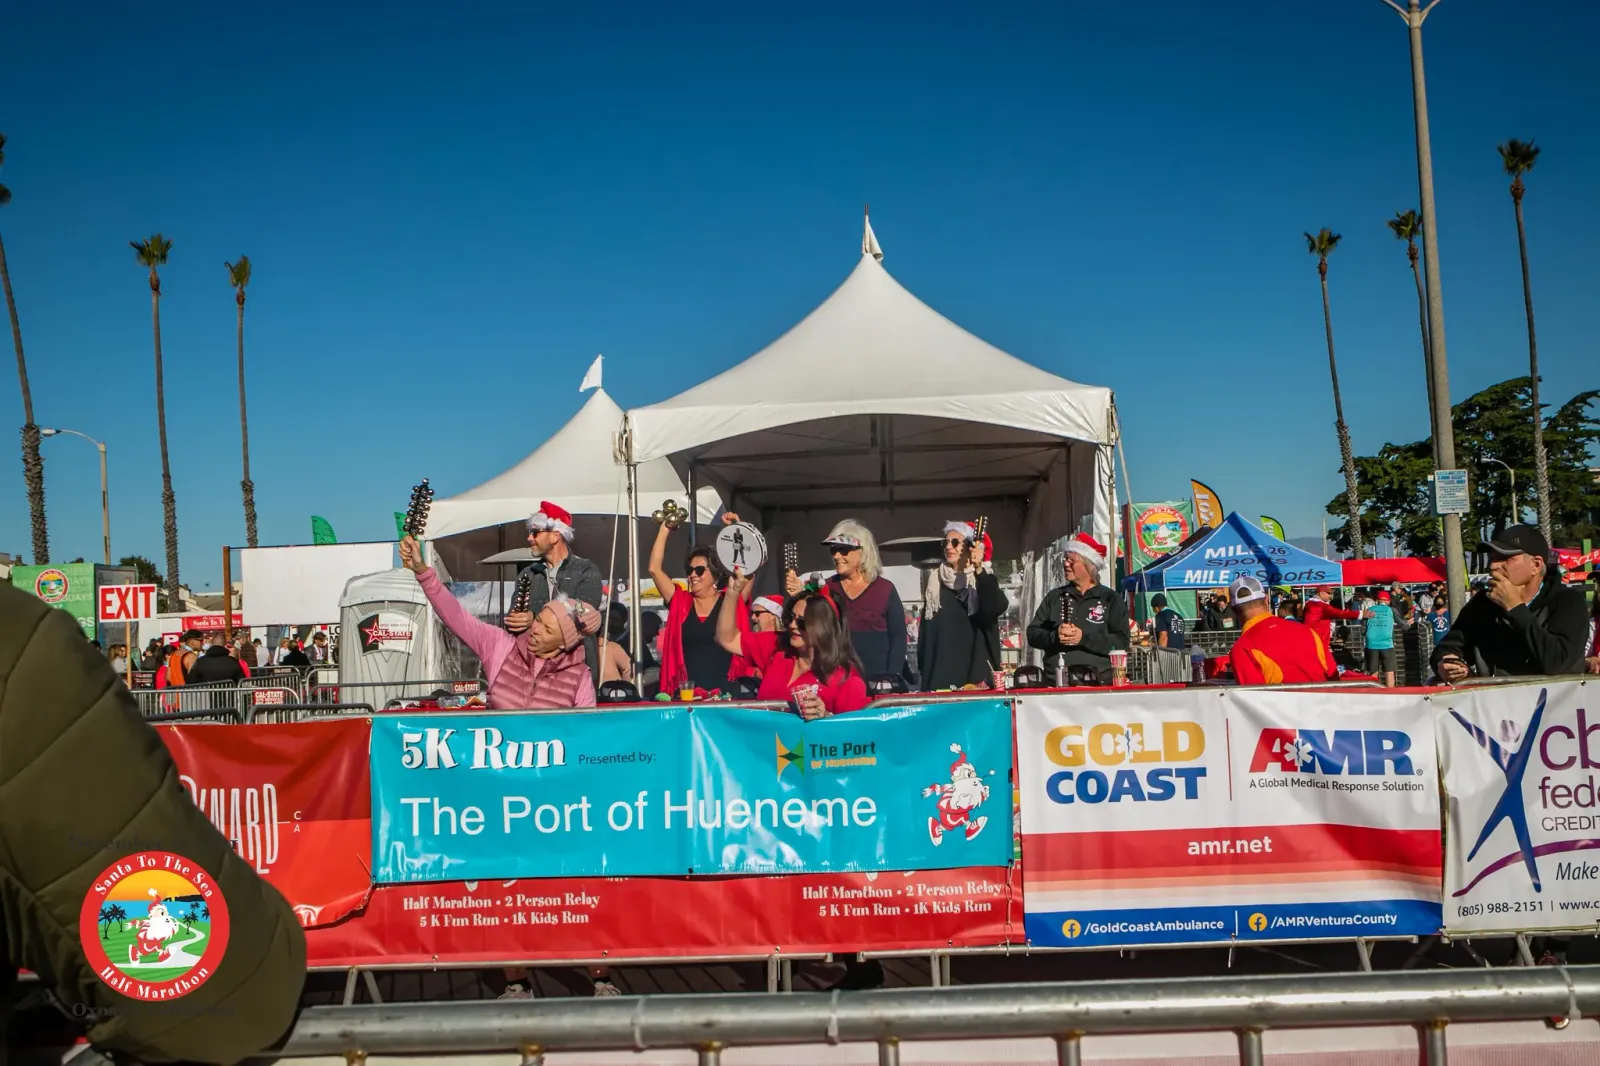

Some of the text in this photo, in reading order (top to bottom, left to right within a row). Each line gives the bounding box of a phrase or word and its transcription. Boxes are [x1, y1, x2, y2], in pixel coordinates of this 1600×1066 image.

[1205, 544, 1263, 559] MILE
[1271, 546, 1286, 555] 26
[1206, 557, 1288, 568] Sports
[1184, 569, 1231, 584] MILE
[1255, 568, 1326, 585] Sports
[101, 586, 156, 620] EXIT
[255, 691, 284, 699] CAL-STATE
[454, 682, 479, 692] CAL-STATE
[401, 727, 567, 770] 5K Run
[809, 741, 876, 758] The Port
[1044, 721, 1206, 767] GOLD
[1249, 727, 1415, 776] AMR
[578, 751, 657, 765] Presented by:
[1046, 767, 1207, 804] COAST
[1249, 777, 1424, 793] A Global Medical Response Solution
[1538, 776, 1600, 809] fed
[400, 789, 877, 836] The Port of Hueneme
[180, 775, 279, 874] NARD
[1187, 836, 1273, 856] amr.net
[1556, 861, 1599, 881] Make
[802, 880, 1002, 900] Half Marathon 2 Person Relay
[403, 892, 600, 910] Half Marathon 2 Person Relay
[844, 904, 870, 916] Fun
[873, 903, 900, 916] Run
[913, 902, 929, 914] 1K
[932, 901, 961, 914] Kids
[965, 900, 992, 913] Run
[1457, 903, 1484, 917] (805)
[1487, 901, 1544, 914] 988-2151
[444, 915, 469, 927] Fun
[473, 914, 500, 926] Run
[512, 914, 528, 925] 1K
[531, 912, 559, 925] Kids
[562, 911, 589, 924] Run
[1084, 919, 1225, 936] /GoldCoastAmbulance
[1270, 913, 1398, 930] /AMRVenturaCounty
